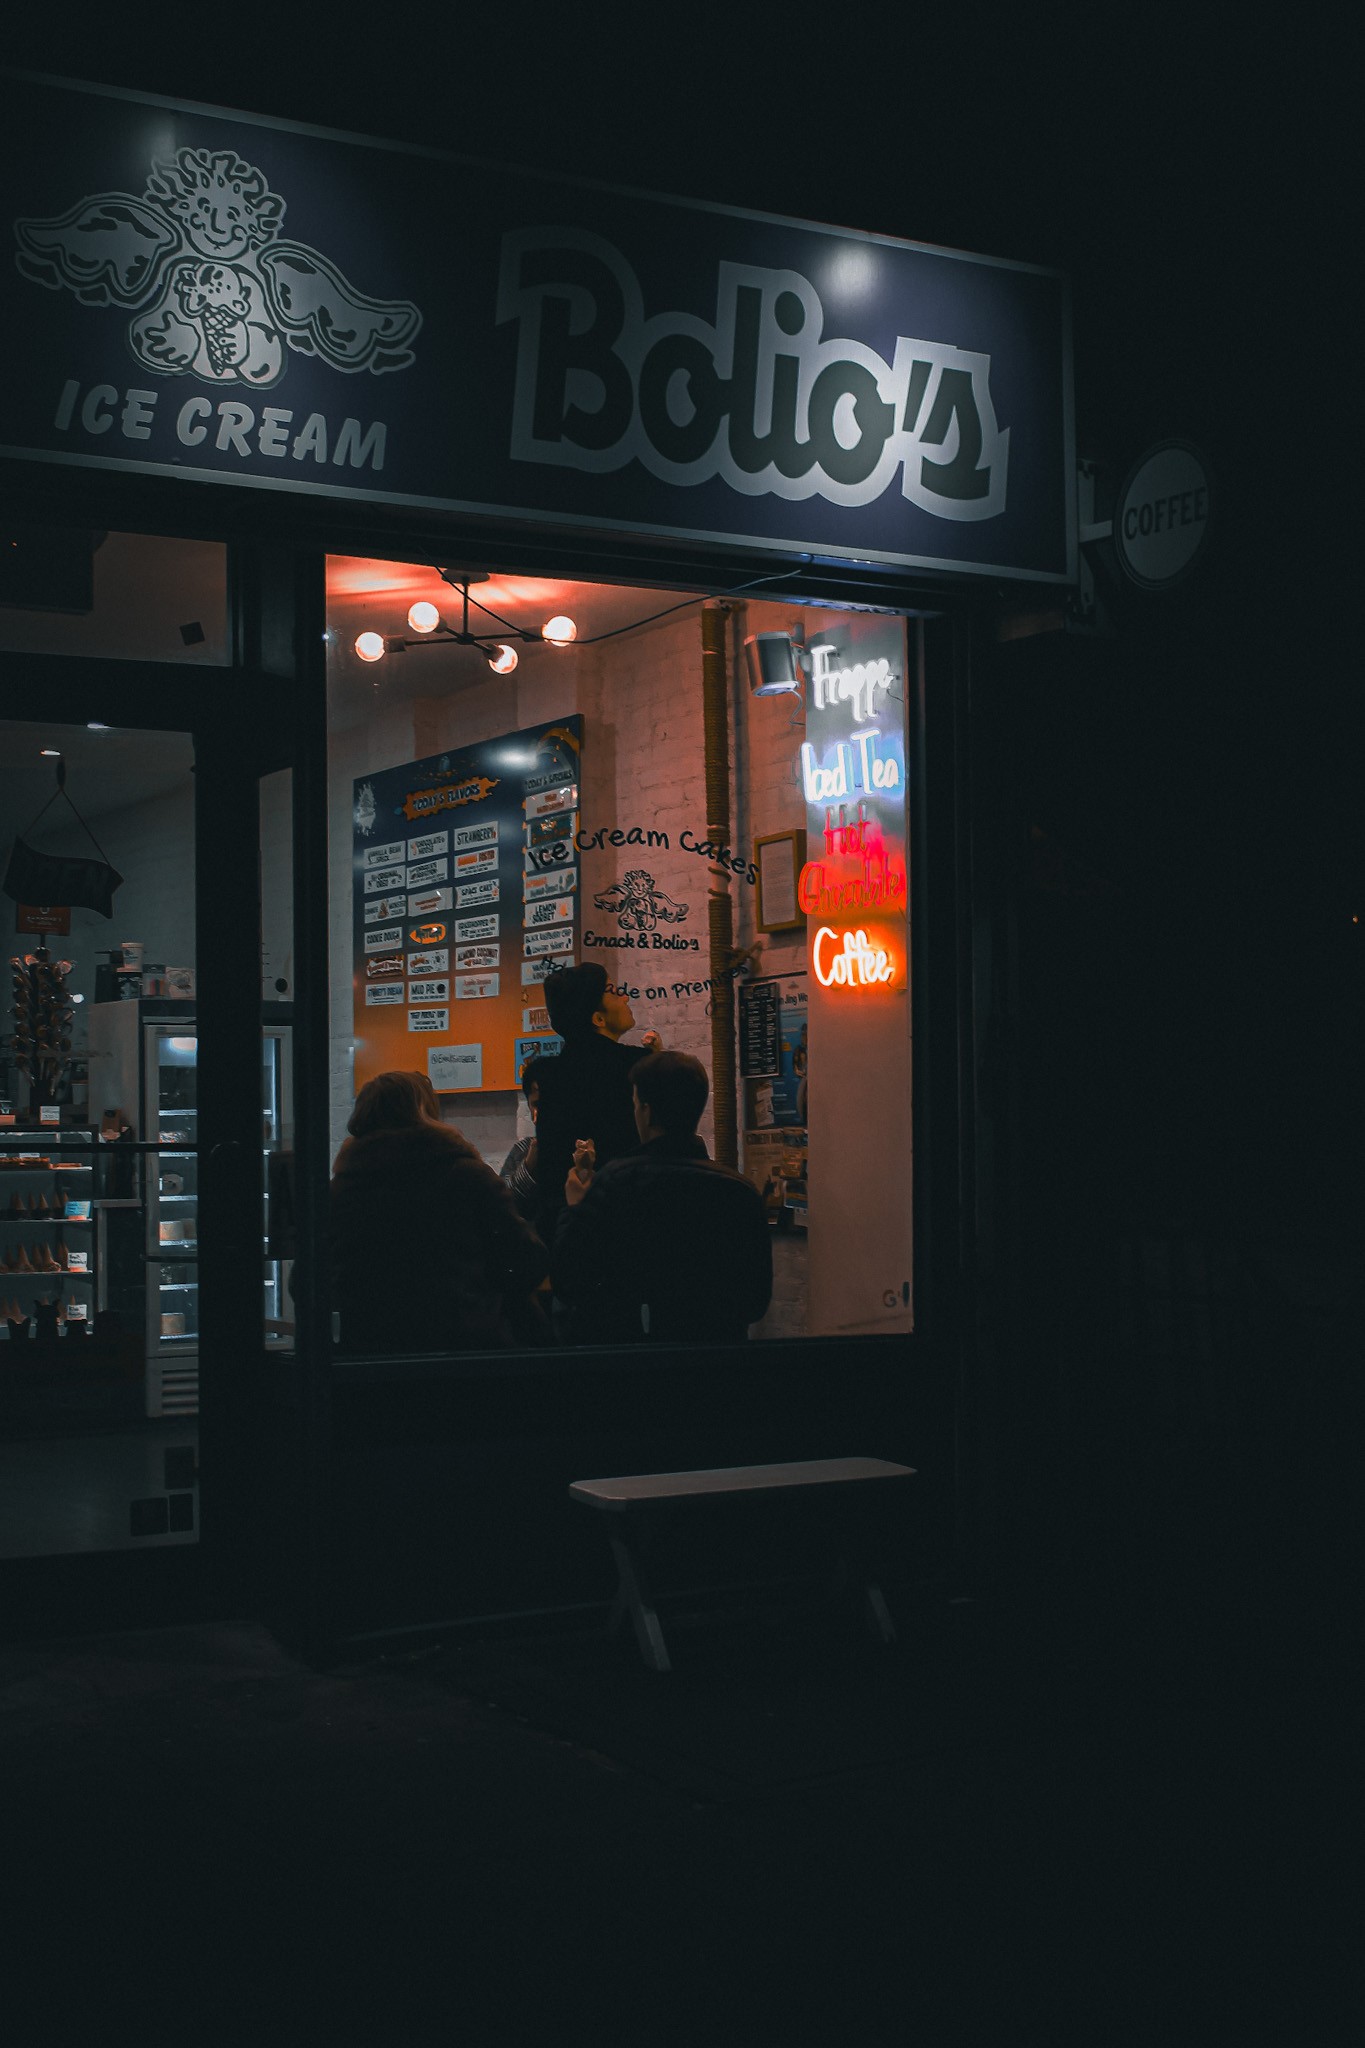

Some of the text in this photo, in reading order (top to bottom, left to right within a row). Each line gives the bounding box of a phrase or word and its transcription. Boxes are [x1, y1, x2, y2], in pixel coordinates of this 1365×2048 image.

[500, 228, 1009, 520] Bolio's
[54, 379, 388, 470] ICE CREAM
[1124, 486, 1206, 540] COFFEE
[851, 729, 899, 795] Tea
[527, 842, 570, 871] Ice
[679, 831, 760, 885] Cakes
[534, 901, 557, 915] LEMON
[583, 930, 634, 949] Emack
[637, 932, 650, 949] &
[812, 926, 895, 987] Coffee
[645, 986, 668, 1000] on
